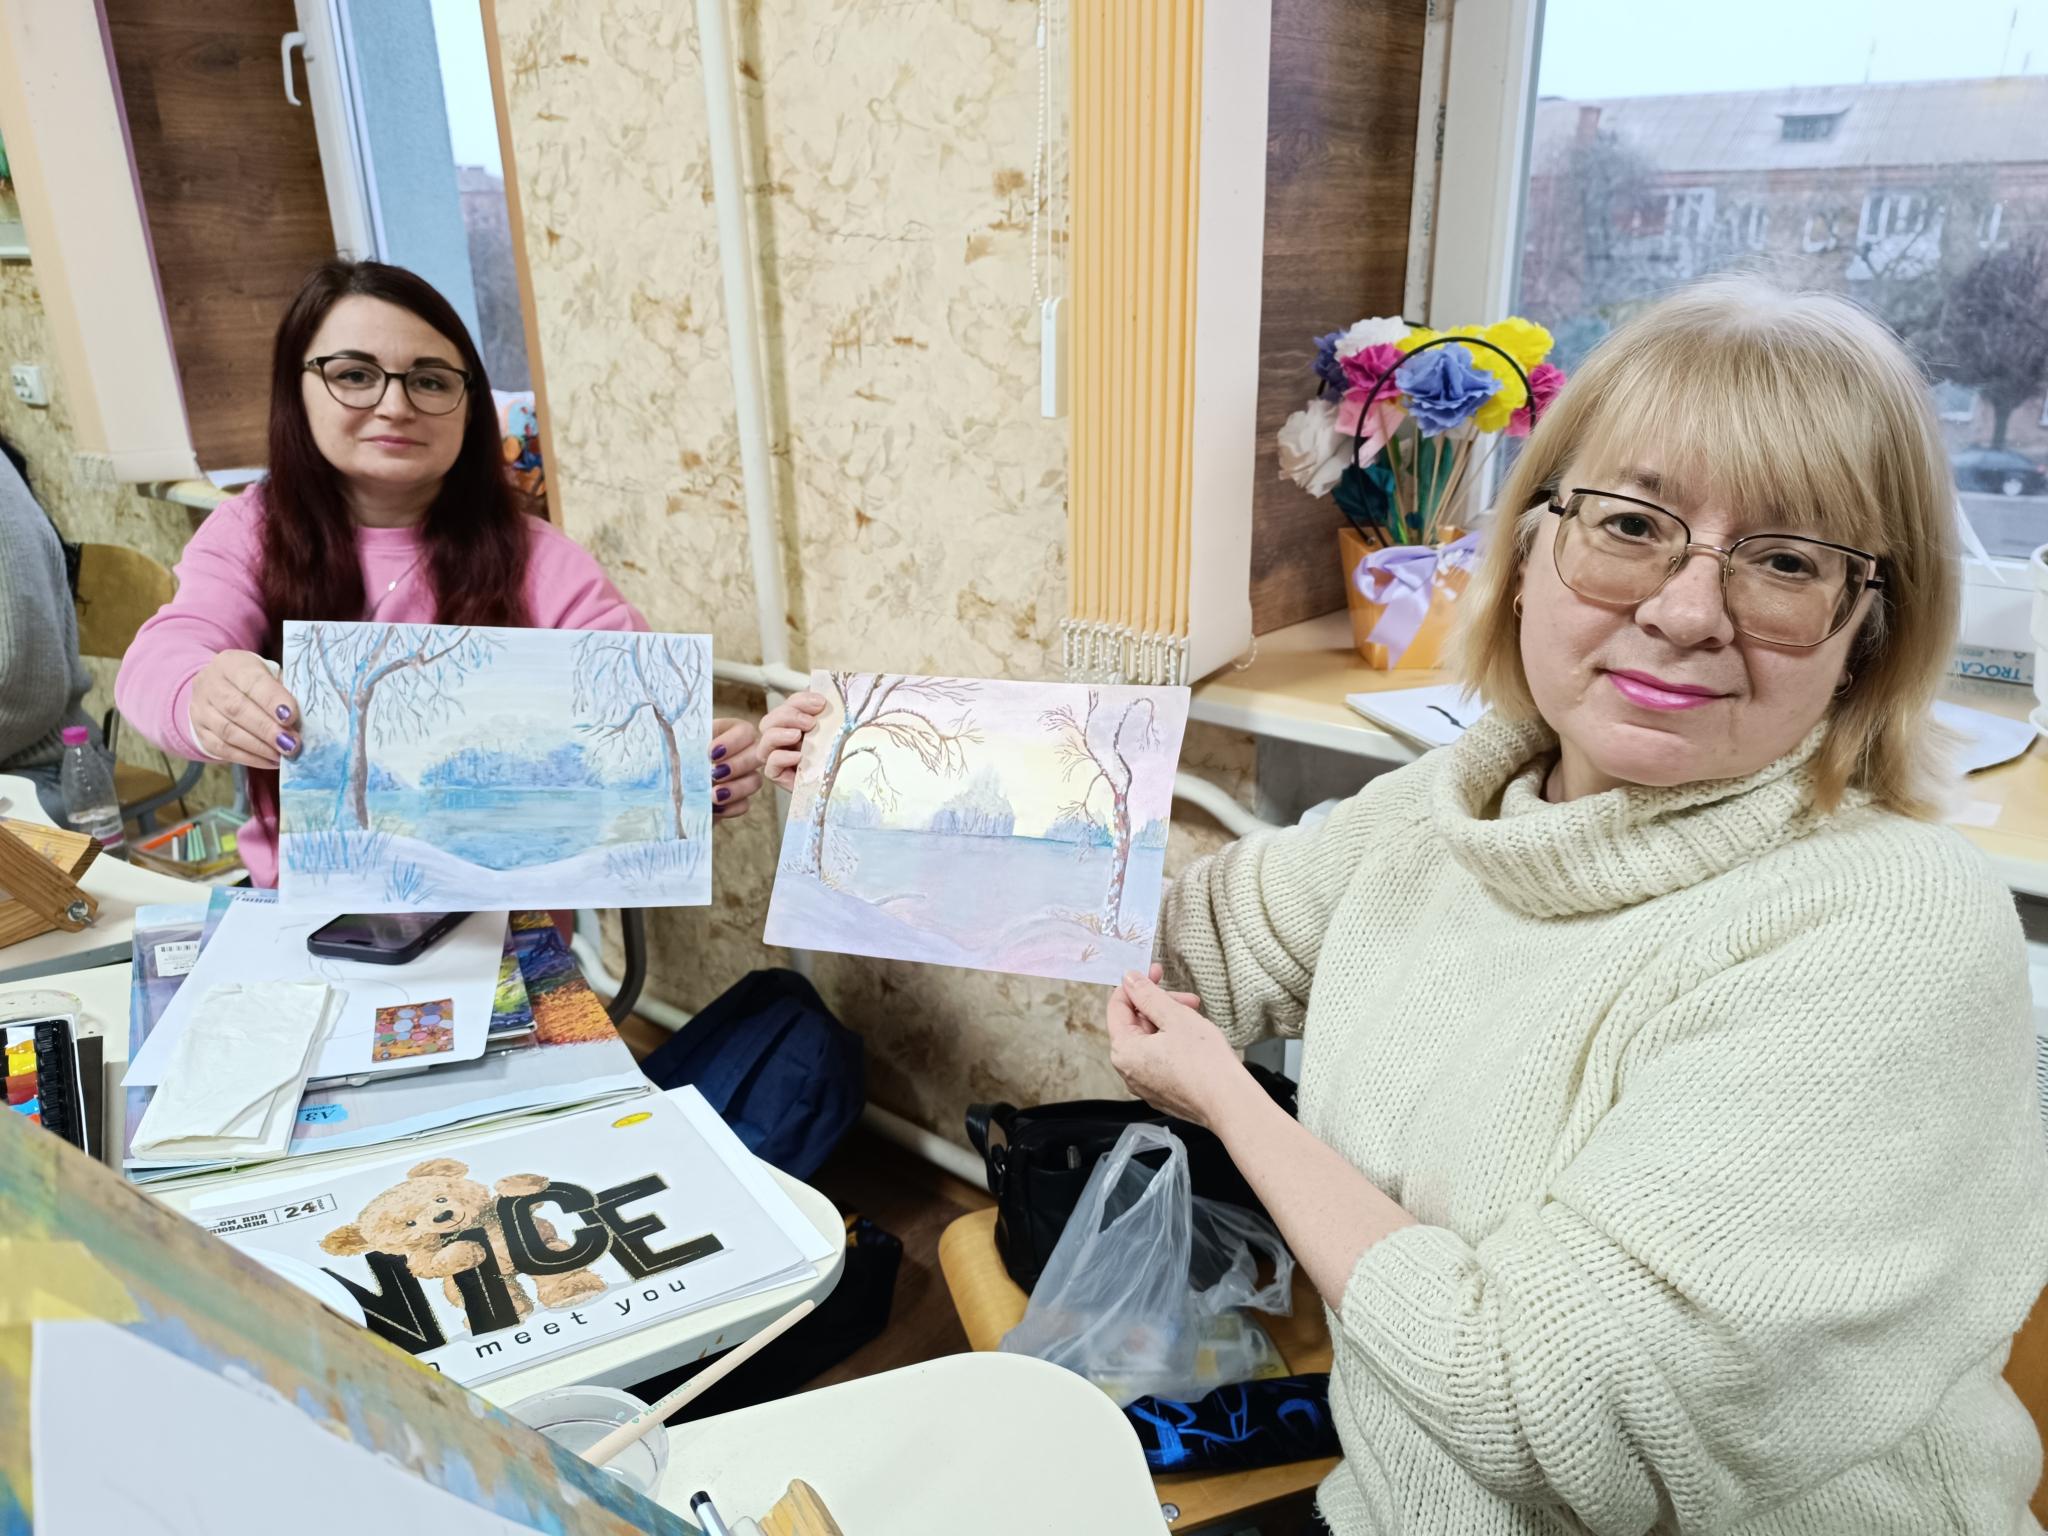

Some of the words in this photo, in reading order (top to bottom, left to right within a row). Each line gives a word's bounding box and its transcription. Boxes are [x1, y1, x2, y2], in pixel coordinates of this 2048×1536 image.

[242, 1213, 266, 1223] ДЛЯ
[284, 1201, 317, 1219] 24
[209, 1219, 268, 1234] ЛЮВАННЯ
[320, 1172, 724, 1355] NICE
[475, 1310, 588, 1359] meet
[615, 1279, 686, 1316] you
